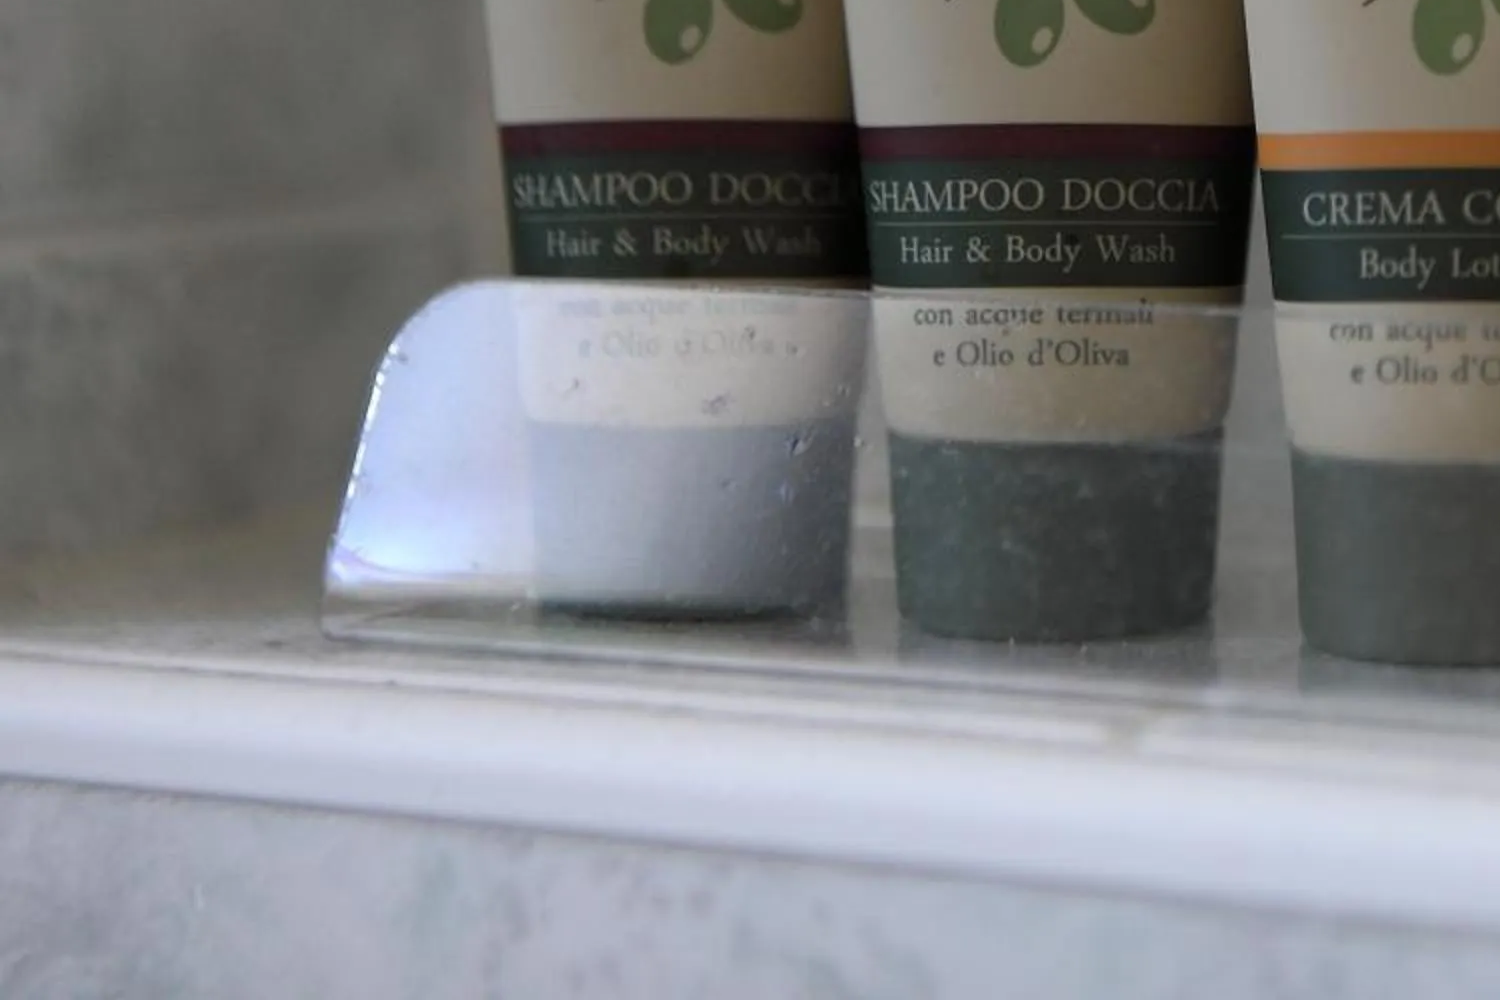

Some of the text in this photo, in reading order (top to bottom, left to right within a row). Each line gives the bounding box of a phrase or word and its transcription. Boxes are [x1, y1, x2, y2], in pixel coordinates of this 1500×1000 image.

[512, 172, 694, 208] SHAMPOO
[868, 178, 1221, 213] SHAMPOO DOCCIA
[1303, 191, 1445, 226] CREMA
[546, 225, 822, 265] Hair & Body Wash
[899, 232, 1176, 274] Hair & Body Wash
[1360, 245, 1436, 290] Body
[913, 306, 952, 327] con
[933, 338, 1130, 368] e Olio d'Oliva
[1329, 321, 1373, 342] con
[1386, 321, 1467, 354] acque
[1350, 364, 1366, 384] e
[1376, 356, 1439, 385] Olio
